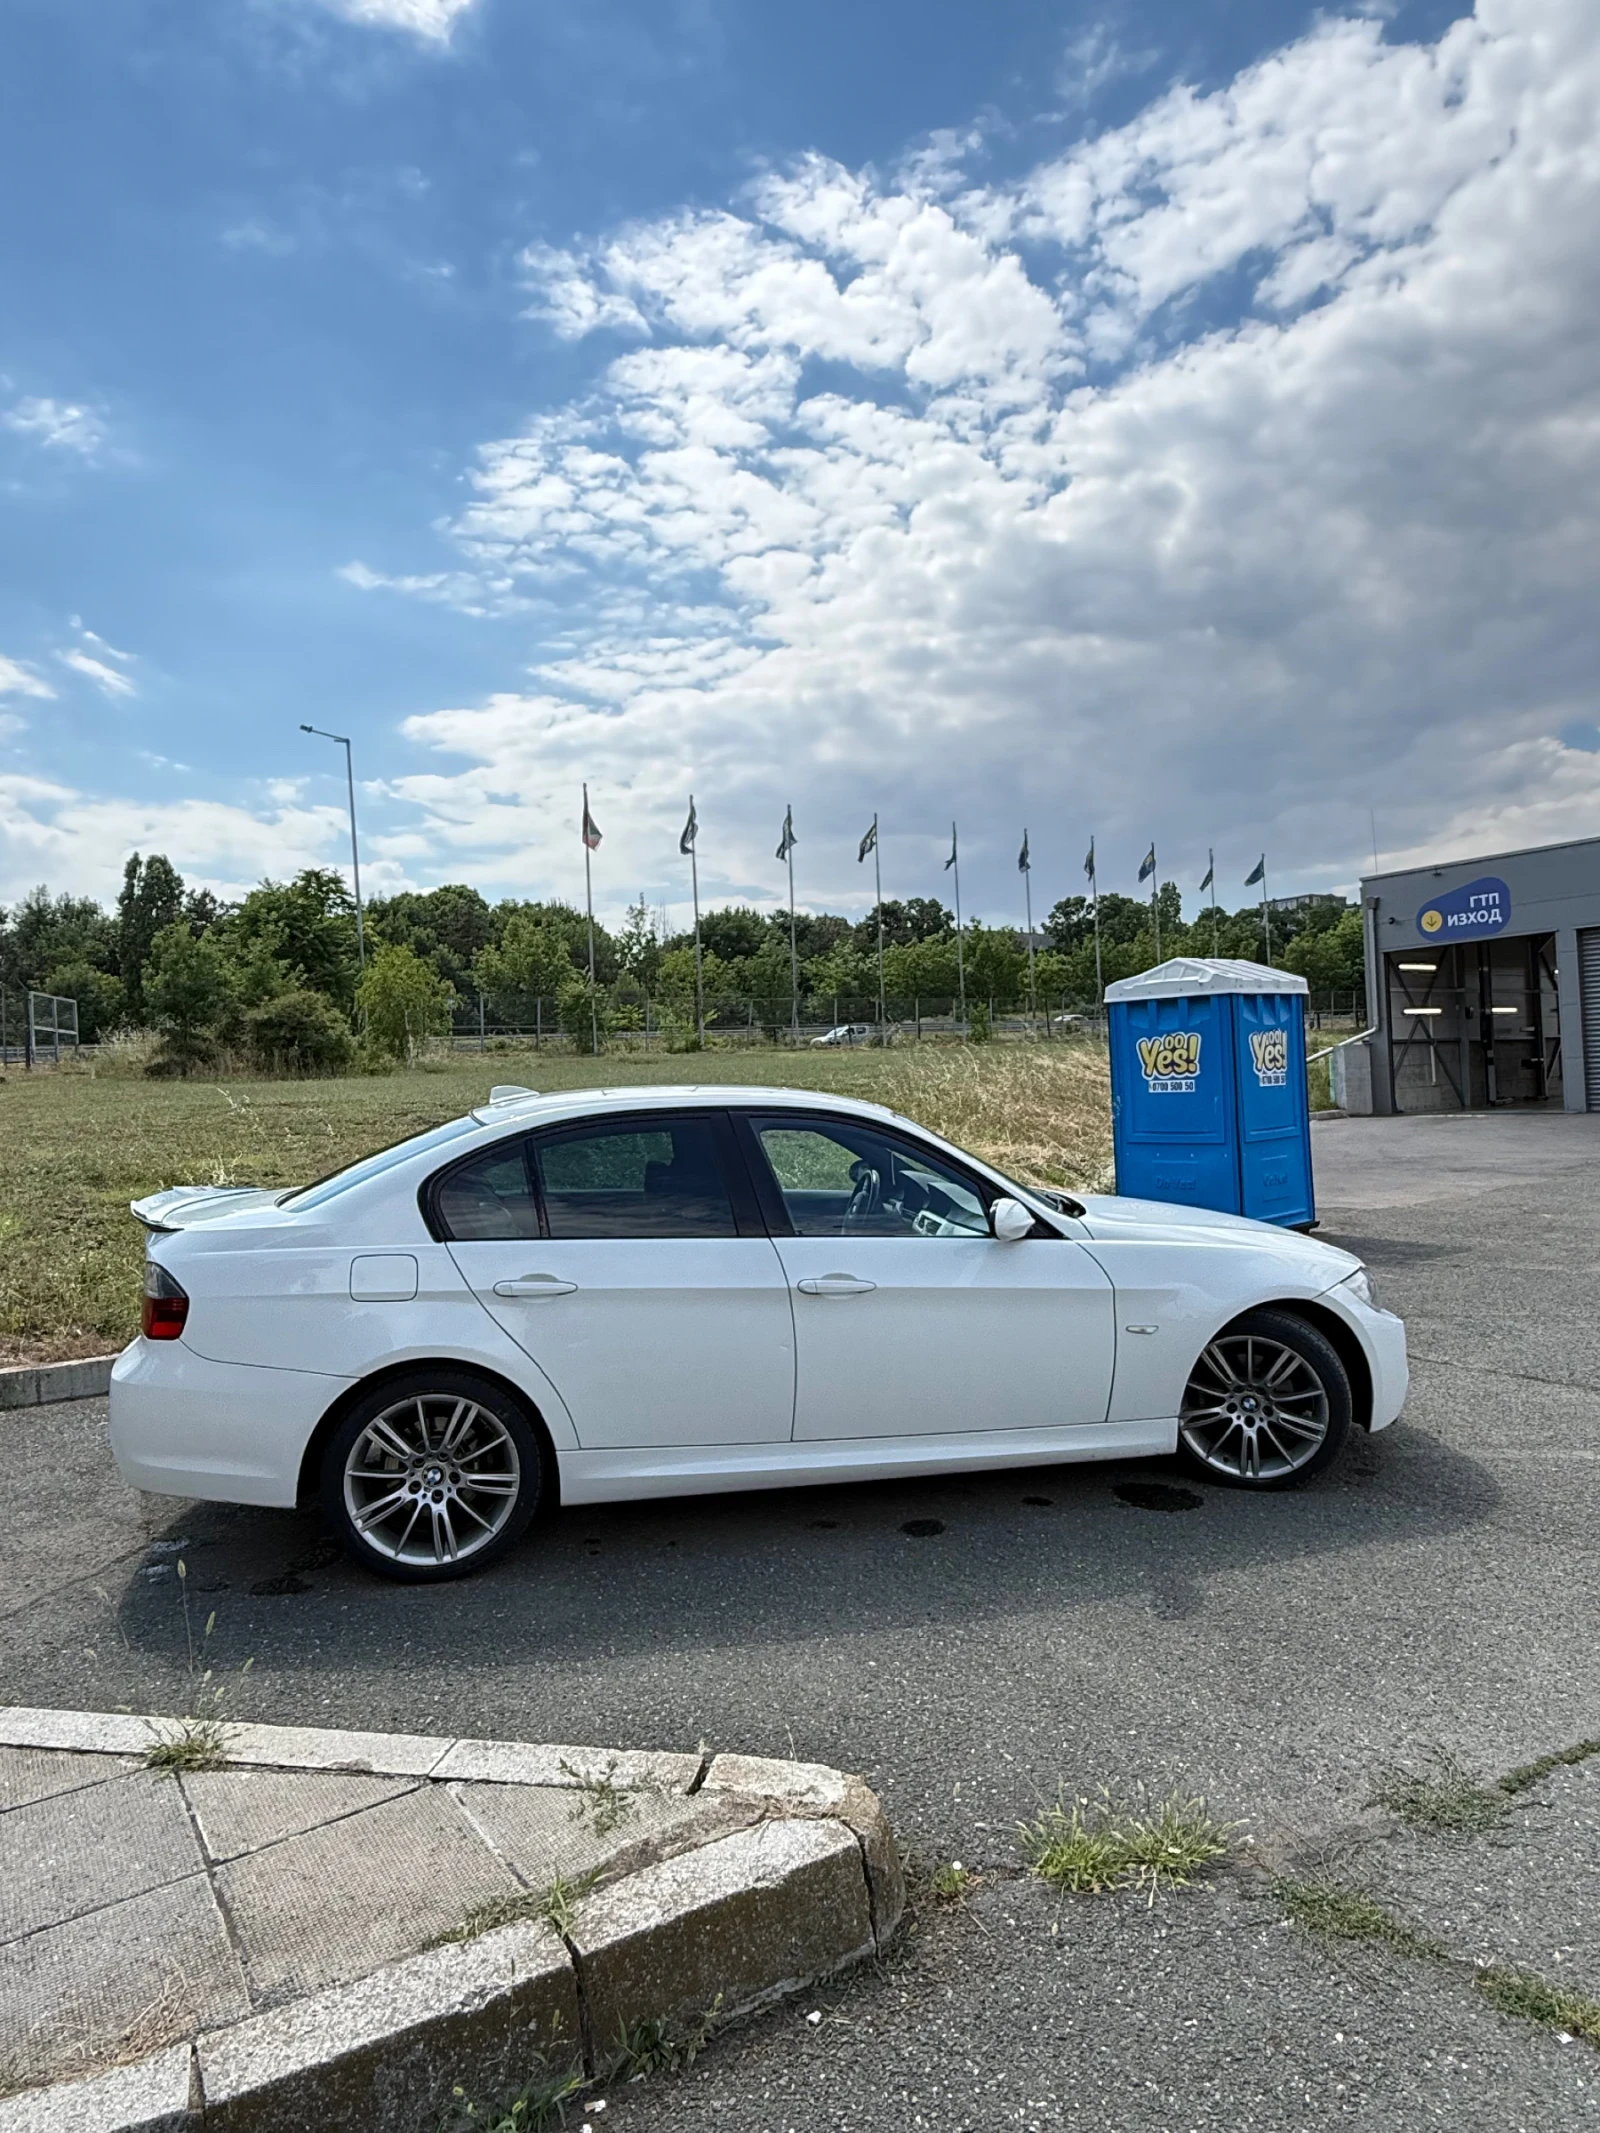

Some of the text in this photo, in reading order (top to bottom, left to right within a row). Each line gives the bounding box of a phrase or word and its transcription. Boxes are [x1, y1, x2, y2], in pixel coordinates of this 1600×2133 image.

[1469, 892, 1500, 908] ГТП
[1447, 908, 1503, 927] ИЗХОД
[1138, 1034, 1200, 1077] Yes!
[1251, 1031, 1287, 1070] Yes!
[1152, 1081, 1194, 1091] 0700 500 50
